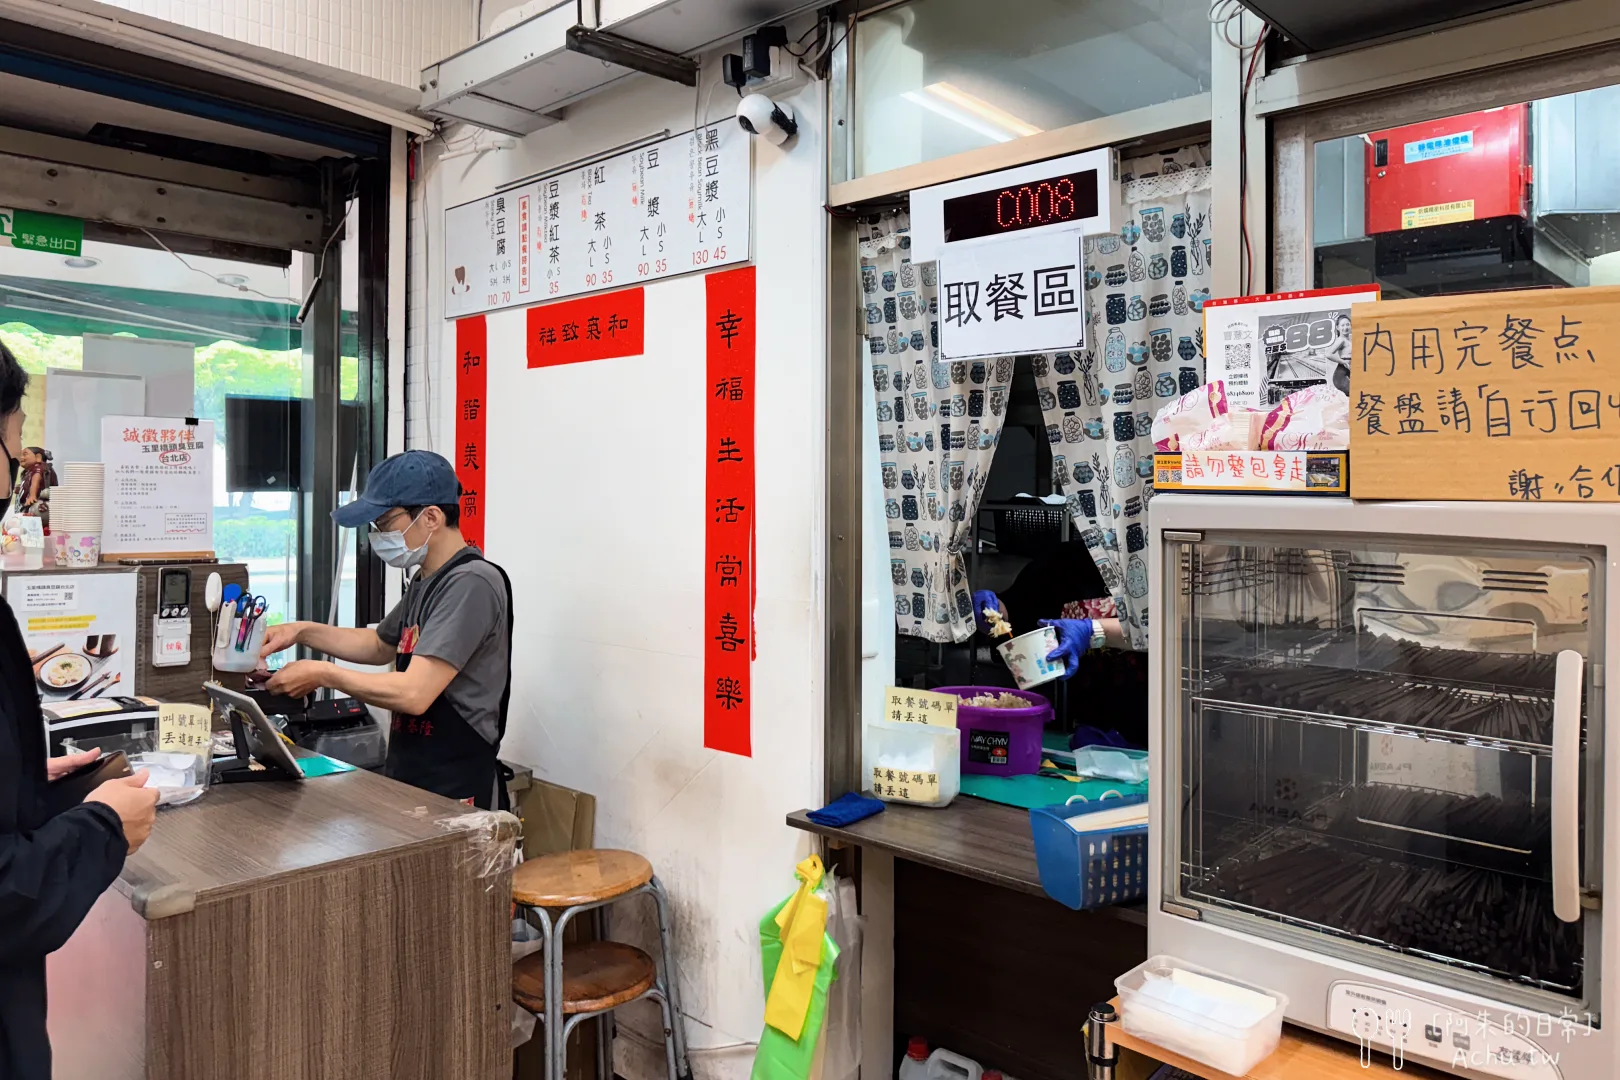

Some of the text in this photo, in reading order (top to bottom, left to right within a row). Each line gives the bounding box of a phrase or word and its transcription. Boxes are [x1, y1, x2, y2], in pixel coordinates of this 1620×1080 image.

[705, 128, 719, 202] 黑豆漿
[647, 148, 660, 218] 豆漿
[594, 165, 606, 232] 紅茶
[696, 179, 704, 210] Soymilk
[496, 197, 506, 256] 臭豆腐
[548, 180, 560, 264] 豆漿紅茶
[21, 233, 77, 252] 緊急出口
[692, 245, 727, 266] 130 45
[637, 258, 667, 277] 90 35
[549, 280, 559, 294] 35
[585, 269, 613, 287] 90 35
[487, 290, 511, 306] 110 70
[943, 264, 1079, 328] 取餐區
[122, 427, 195, 444] 誠徵夥伴
[141, 441, 205, 454] 玉里橋頭臭豆腐
[161, 453, 188, 463] 台北店
[1184, 453, 1306, 483] 請勿整包拿走
[714, 309, 746, 711] 幸福生活常喜樂
[891, 694, 956, 714] 取餐號碼單
[891, 709, 929, 725] 請丟這
[873, 767, 938, 787] 取餐號碼單
[873, 782, 910, 799] 請丟這
